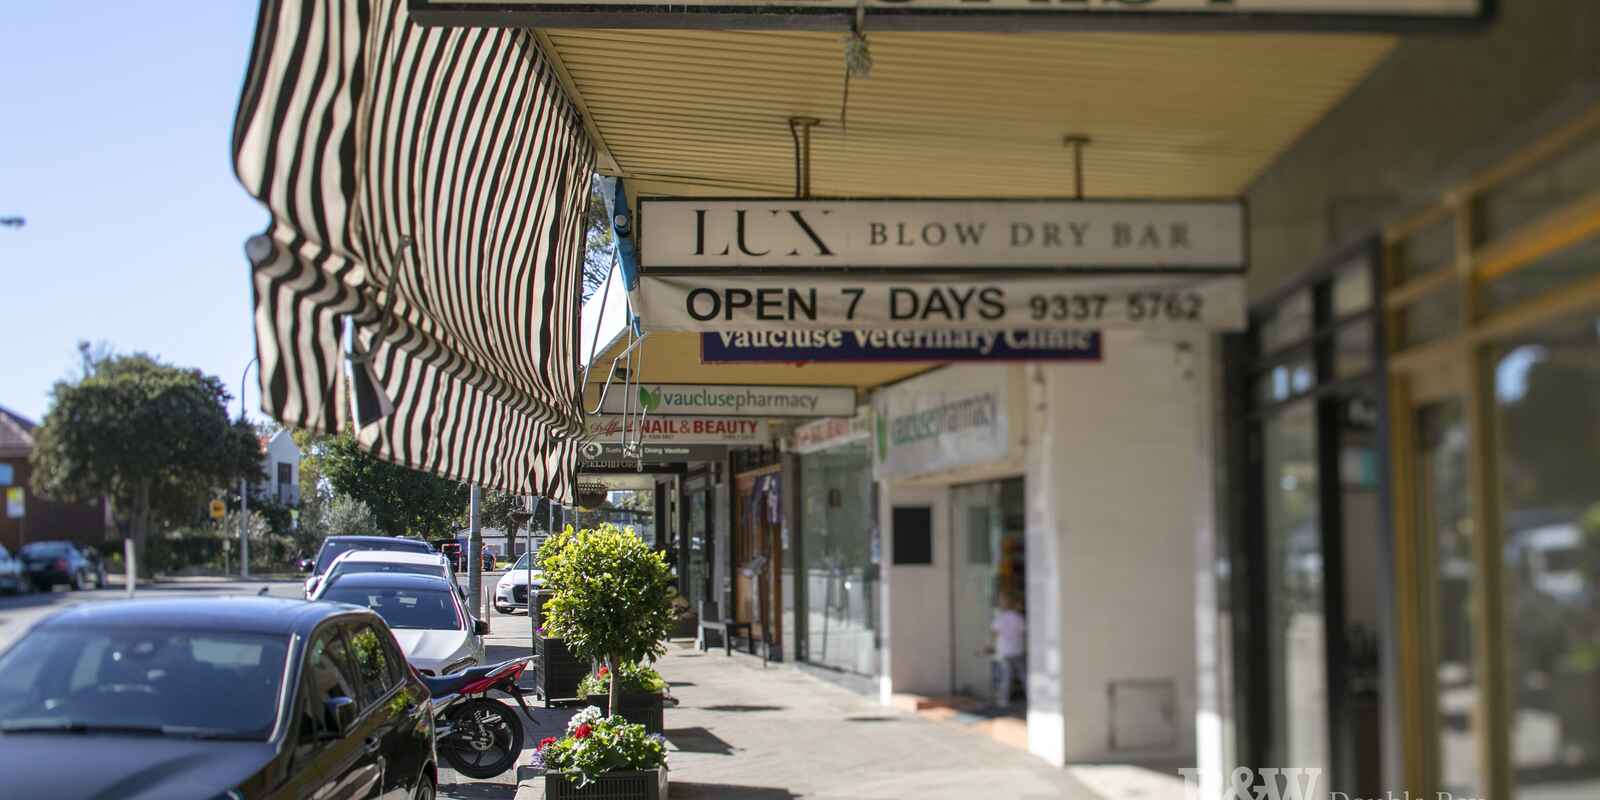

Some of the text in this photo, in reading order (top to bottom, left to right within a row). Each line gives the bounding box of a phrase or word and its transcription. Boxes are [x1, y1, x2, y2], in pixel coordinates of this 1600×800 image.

[693, 208, 1193, 257] LUX BLOW DRY BAR
[685, 287, 1204, 322] OPEN 7 DAYS 9337 5762
[664, 387, 818, 411] vauclusepharmacy
